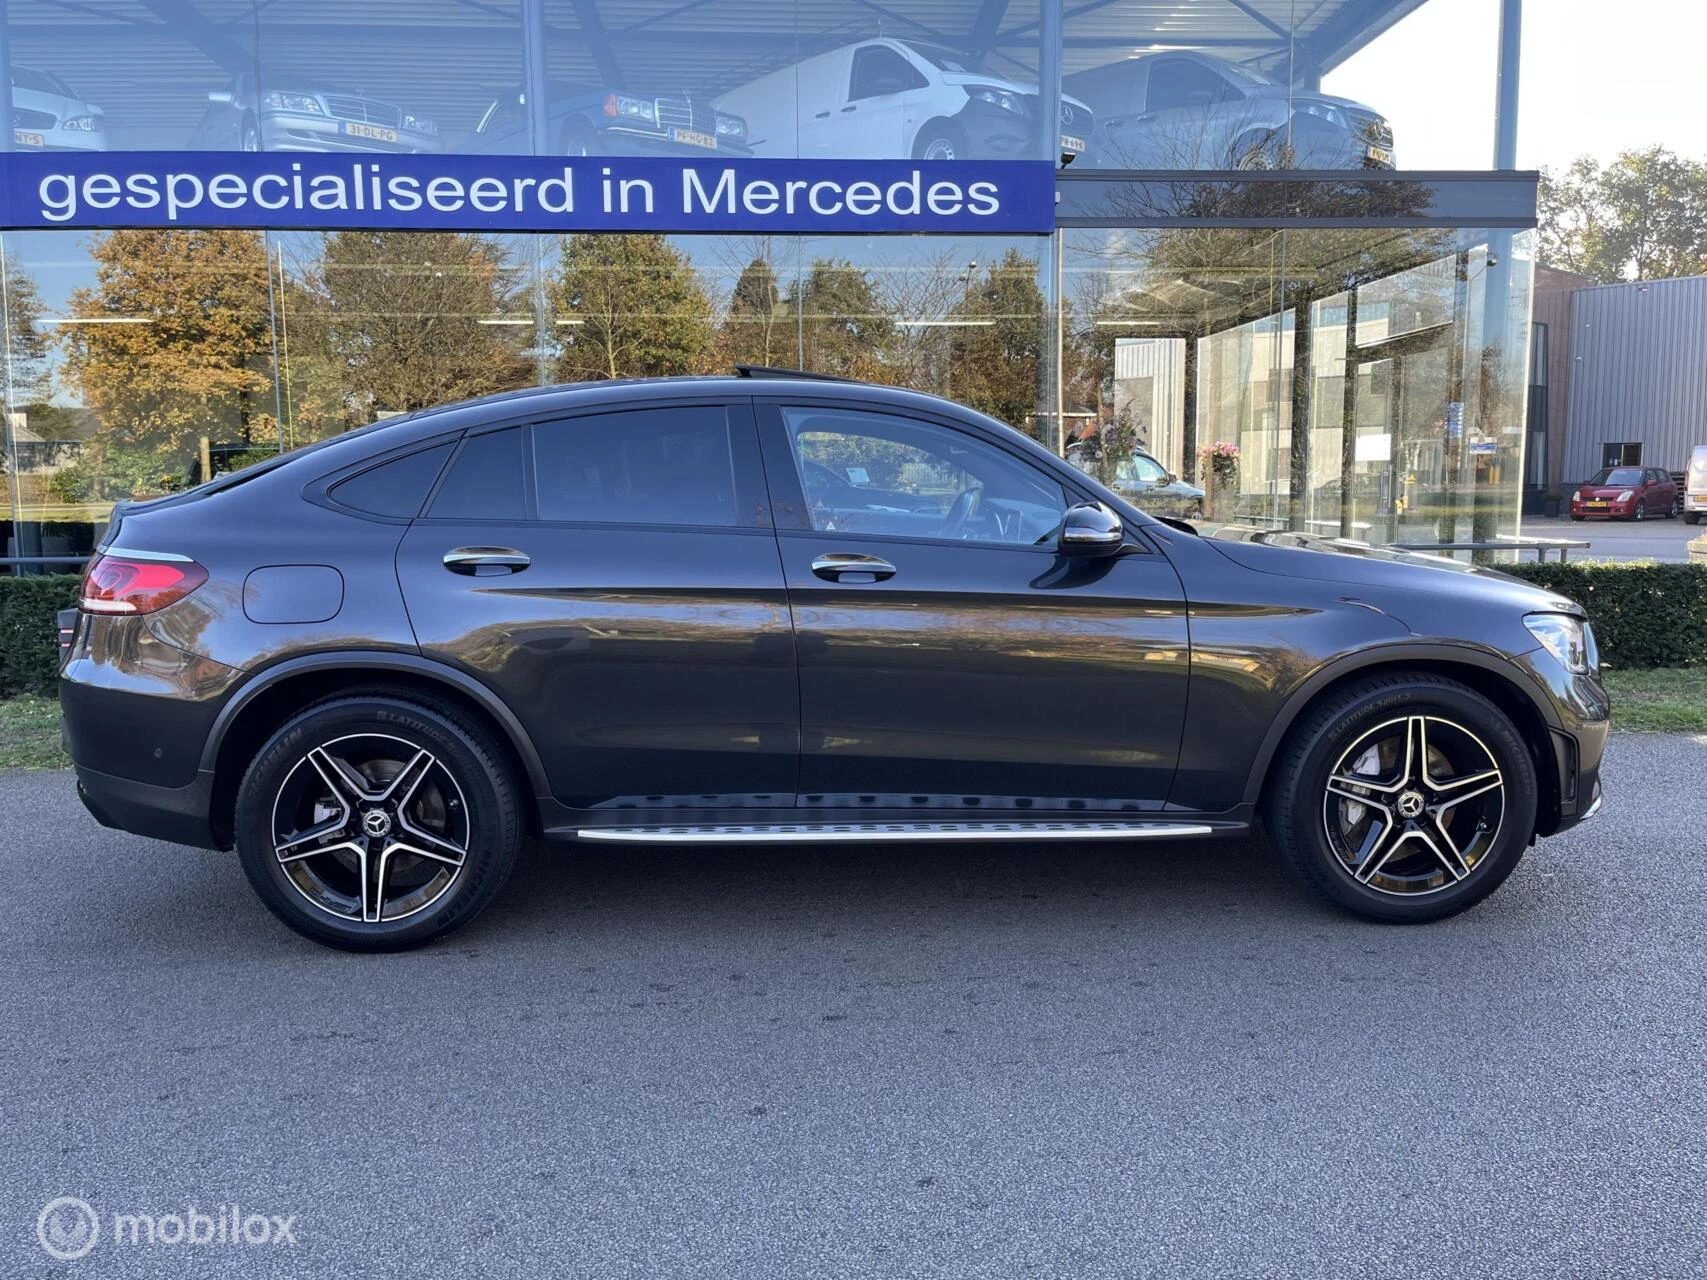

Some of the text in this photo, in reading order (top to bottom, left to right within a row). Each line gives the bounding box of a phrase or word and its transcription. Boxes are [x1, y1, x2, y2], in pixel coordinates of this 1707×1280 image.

[349, 124, 394, 141] 31-DL-PG
[38, 163, 1000, 222] gespecialiseerd in Mercedes
